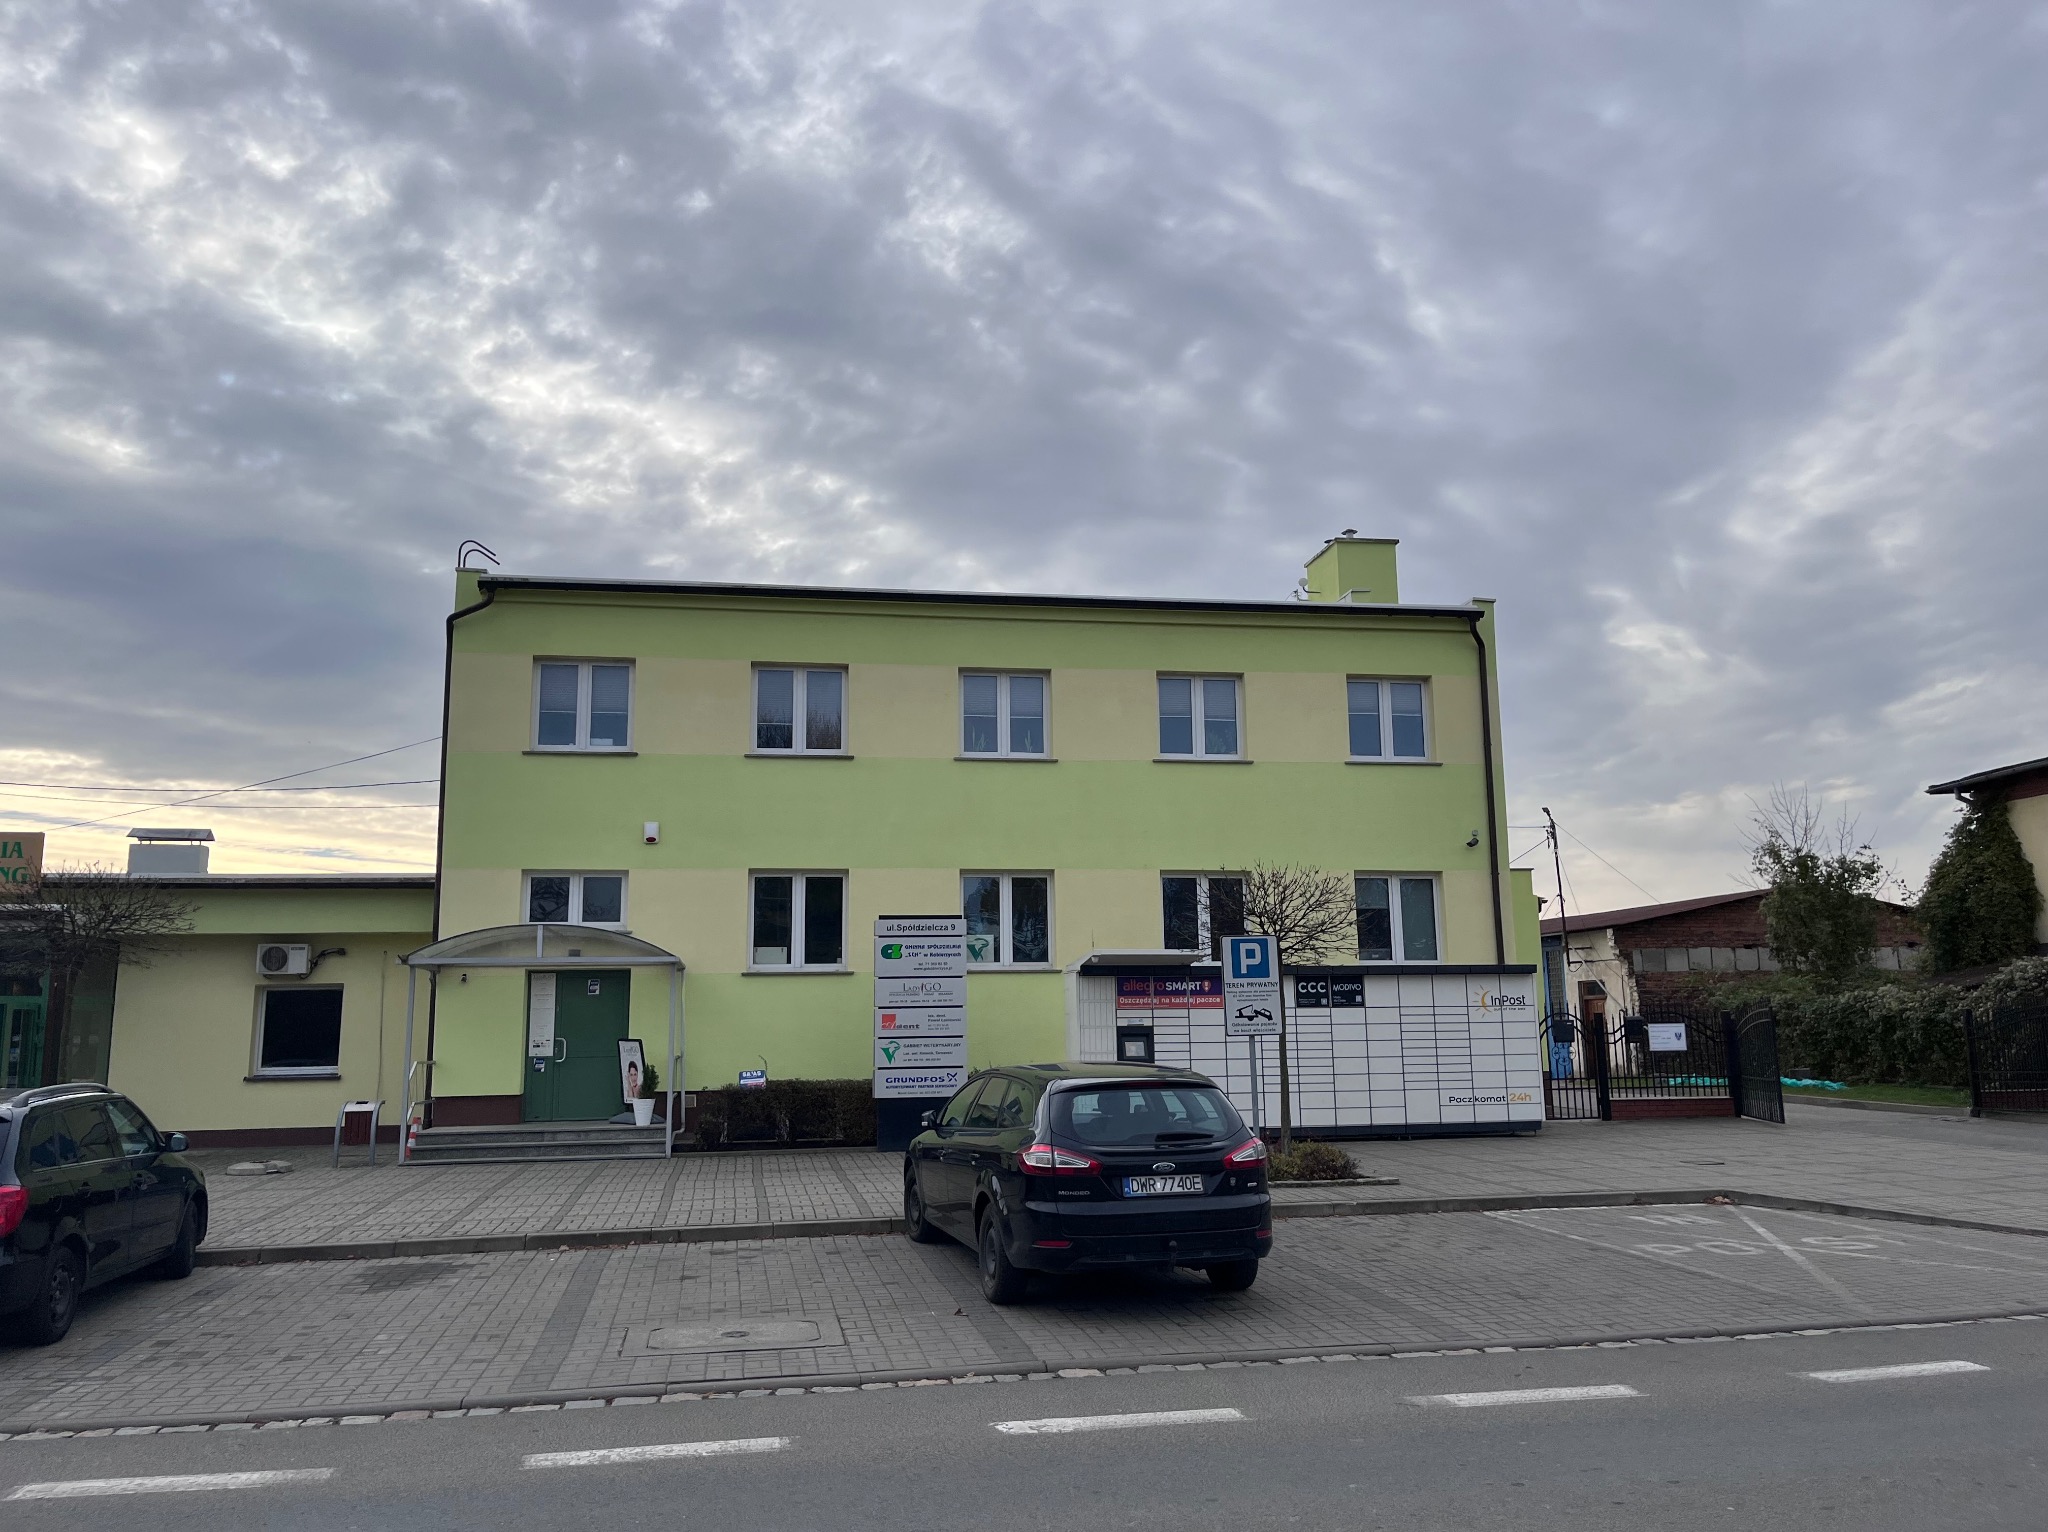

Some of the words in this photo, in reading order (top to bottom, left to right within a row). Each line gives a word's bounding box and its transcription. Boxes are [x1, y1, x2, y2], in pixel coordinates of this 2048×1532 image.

[950, 923, 956, 931] 9
[1239, 942, 1262, 974] P
[1122, 978, 1165, 994] allegro
[1165, 981, 1202, 991] SMART
[1225, 981, 1245, 989] TEREN
[1246, 981, 1279, 989] PRYWATNY
[1298, 982, 1327, 993] CCC
[1332, 983, 1362, 991] MODIVO
[1119, 996, 1160, 1005] Oszczędzaj
[1171, 996, 1196, 1004] każdej
[1196, 997, 1221, 1005] paczce
[1490, 995, 1526, 1006] InPost
[1449, 1095, 1507, 1103] Paczkomat
[1509, 1092, 1532, 1102] 24h
[1130, 1178, 1157, 1194] DWR
[1160, 1175, 1202, 1192] 7740E
